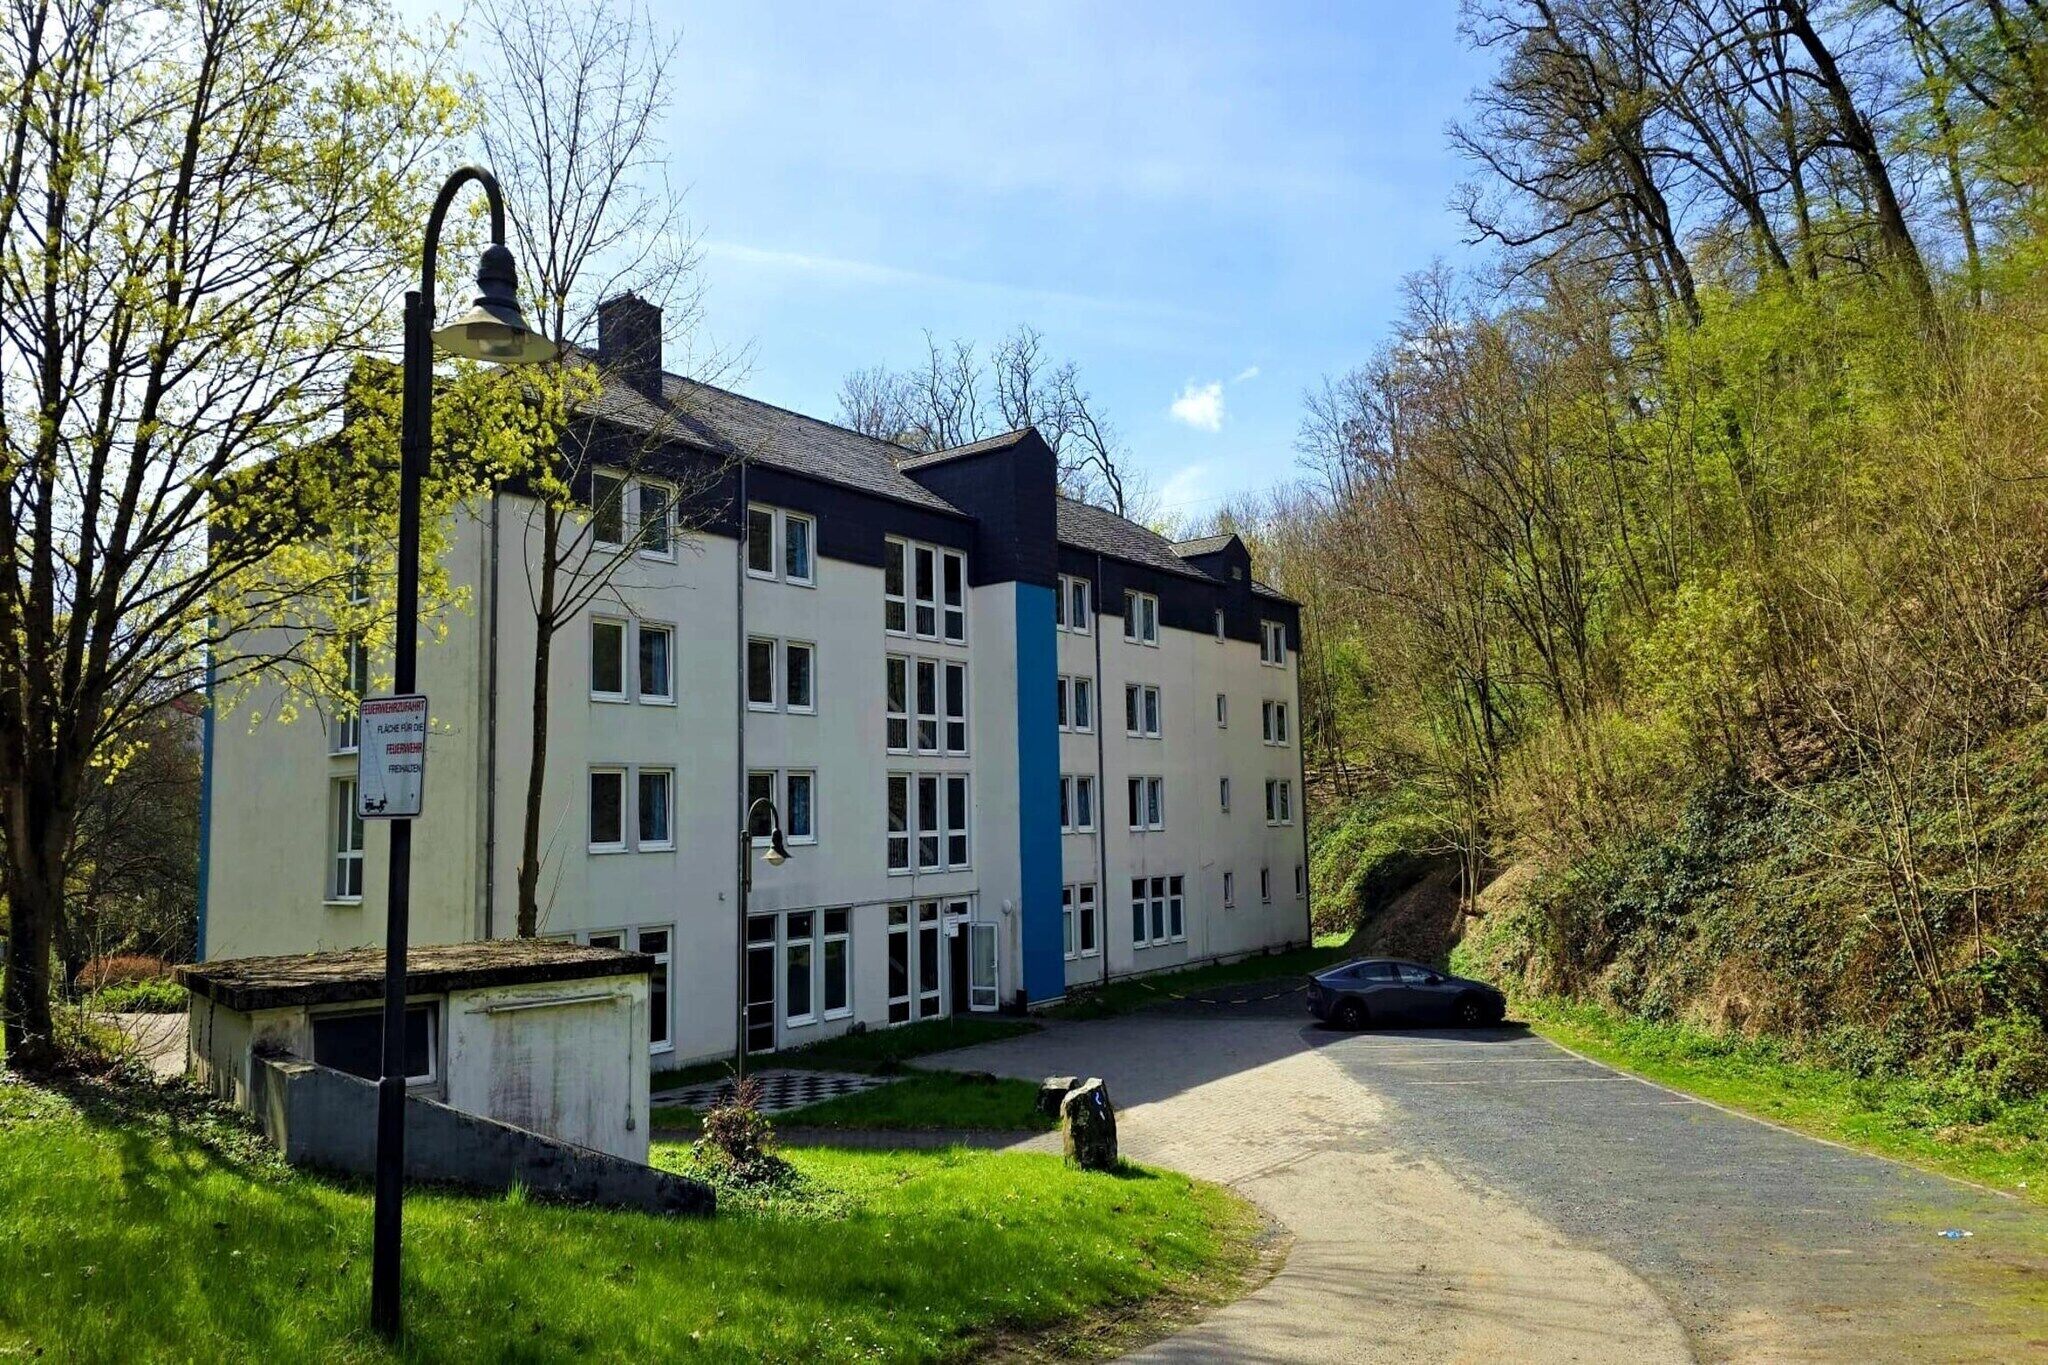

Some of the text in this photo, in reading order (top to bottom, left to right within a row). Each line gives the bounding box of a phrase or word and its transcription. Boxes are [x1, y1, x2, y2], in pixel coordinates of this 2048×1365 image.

[377, 723, 424, 734] FLÄCHE FÜR DIE
[386, 743, 423, 755] FEUERWEHR
[388, 764, 422, 774] FREIHALTEN
